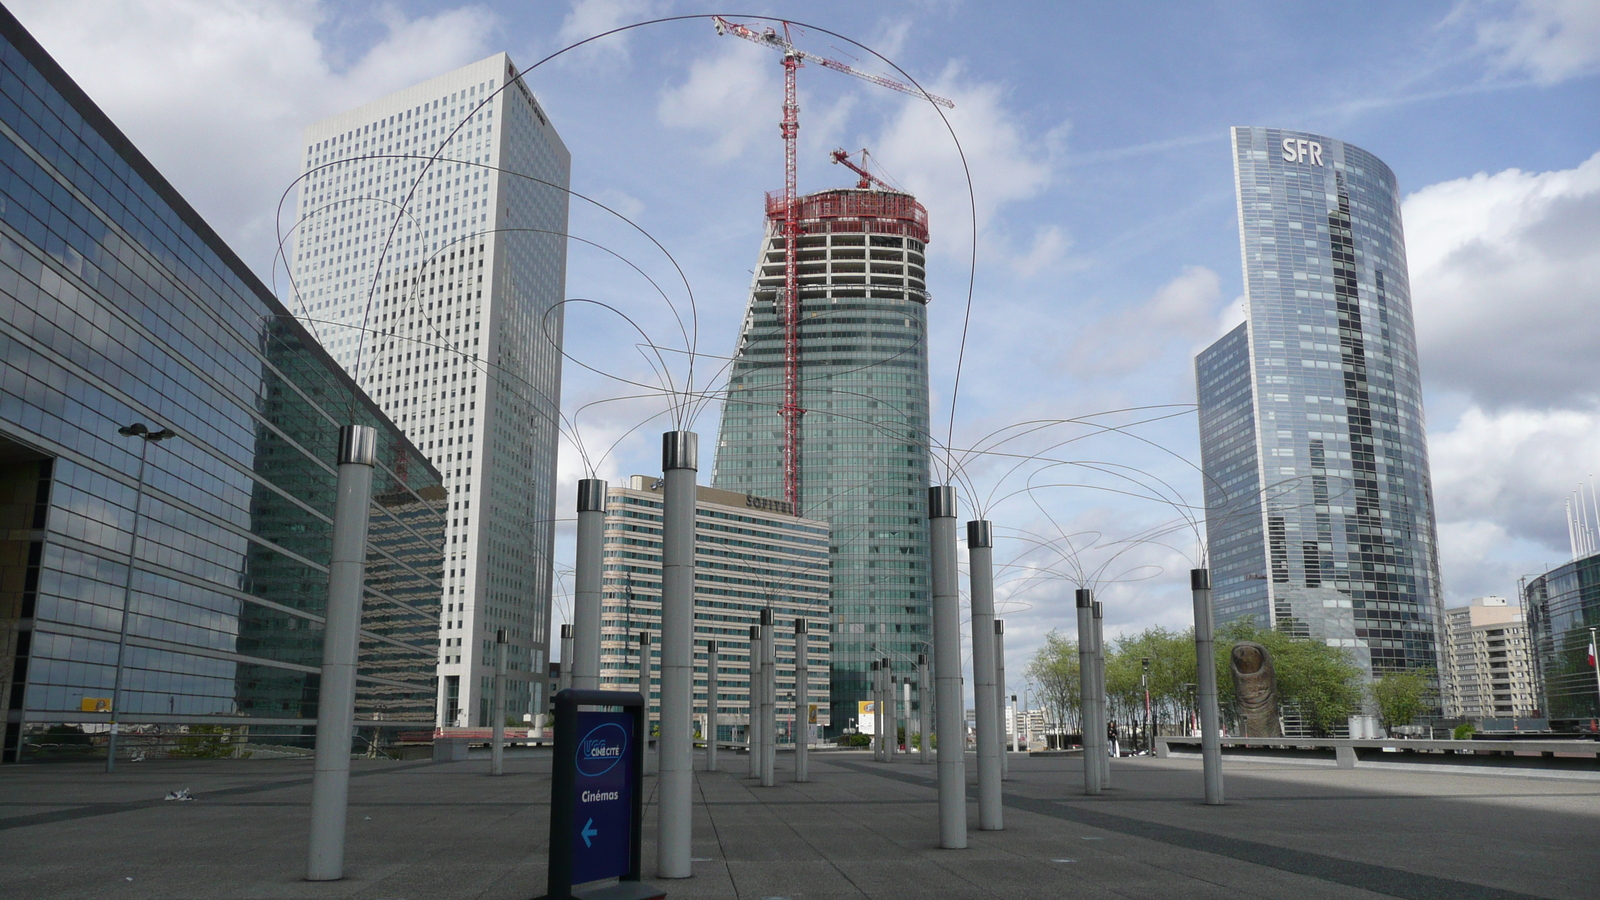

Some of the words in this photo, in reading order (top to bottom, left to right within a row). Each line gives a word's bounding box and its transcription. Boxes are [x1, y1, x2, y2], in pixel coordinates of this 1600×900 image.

[1282, 137, 1324, 167] SFR
[746, 494, 794, 515] SOFITEL
[581, 789, 619, 803] Cinémas
